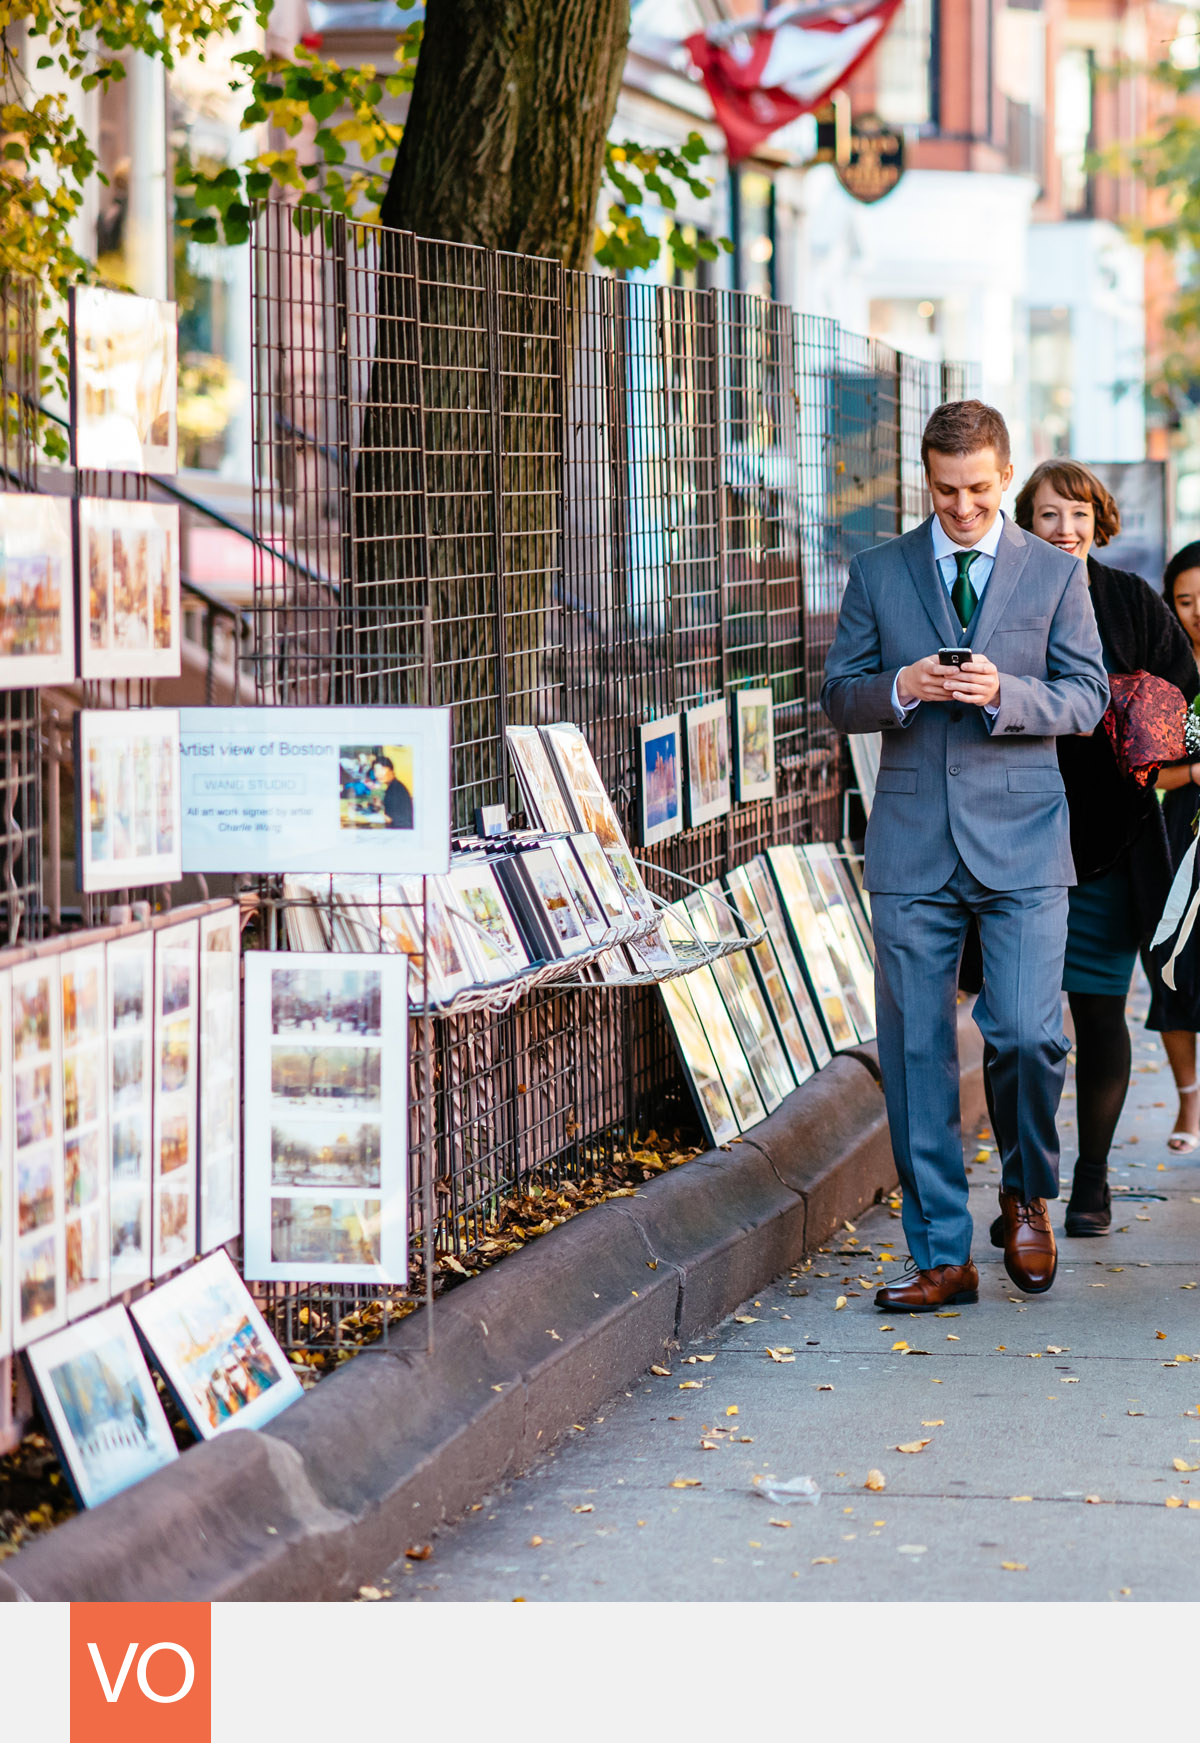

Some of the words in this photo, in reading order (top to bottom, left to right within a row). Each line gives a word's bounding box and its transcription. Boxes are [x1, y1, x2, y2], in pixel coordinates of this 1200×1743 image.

[179, 742, 215, 757] Artist
[219, 741, 256, 757] view
[259, 741, 275, 757] of
[279, 741, 334, 757] Boston
[247, 779, 297, 791] STUDIO
[186, 807, 200, 817] All
[201, 807, 215, 817] art
[216, 807, 239, 817] work
[217, 822, 253, 833] Charlie
